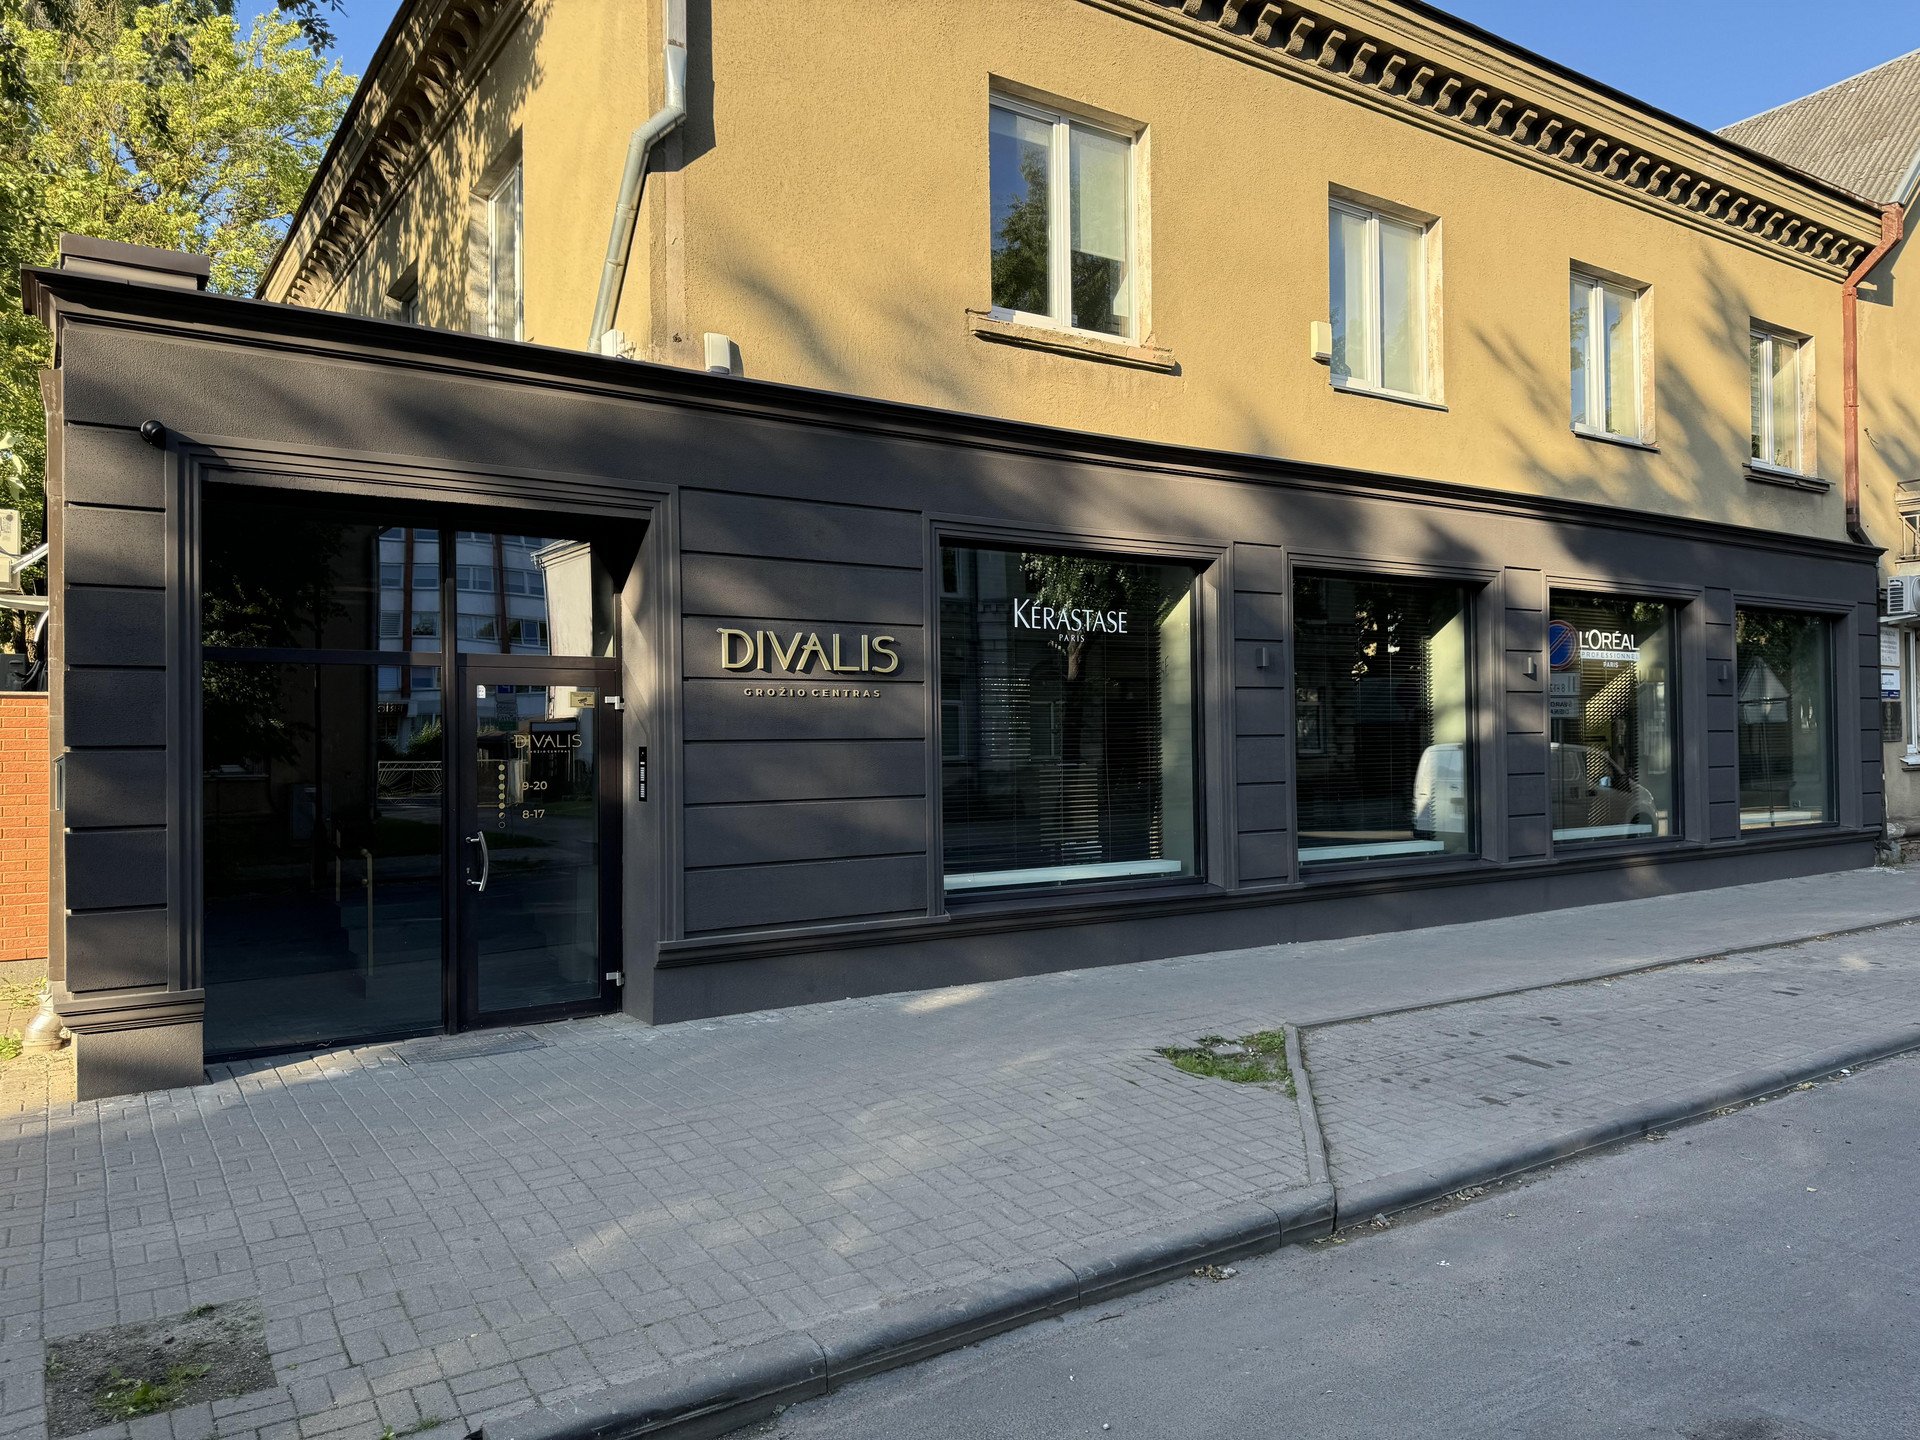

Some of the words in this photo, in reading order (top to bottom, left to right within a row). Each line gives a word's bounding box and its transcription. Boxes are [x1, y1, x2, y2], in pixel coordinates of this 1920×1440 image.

[1014, 598, 1128, 634] KÉRASTASE
[1058, 633, 1085, 643] PARIS
[1579, 629, 1640, 650] L'ORÉAL
[716, 628, 899, 673] DIVALIS
[1581, 651, 1640, 660] PROFESSIONNEL
[743, 686, 806, 697] GROŽIO
[811, 688, 880, 698] CENTRAS
[514, 734, 583, 749] DIVALIS
[522, 781, 548, 791] 9-20
[522, 809, 546, 819] 8-17
